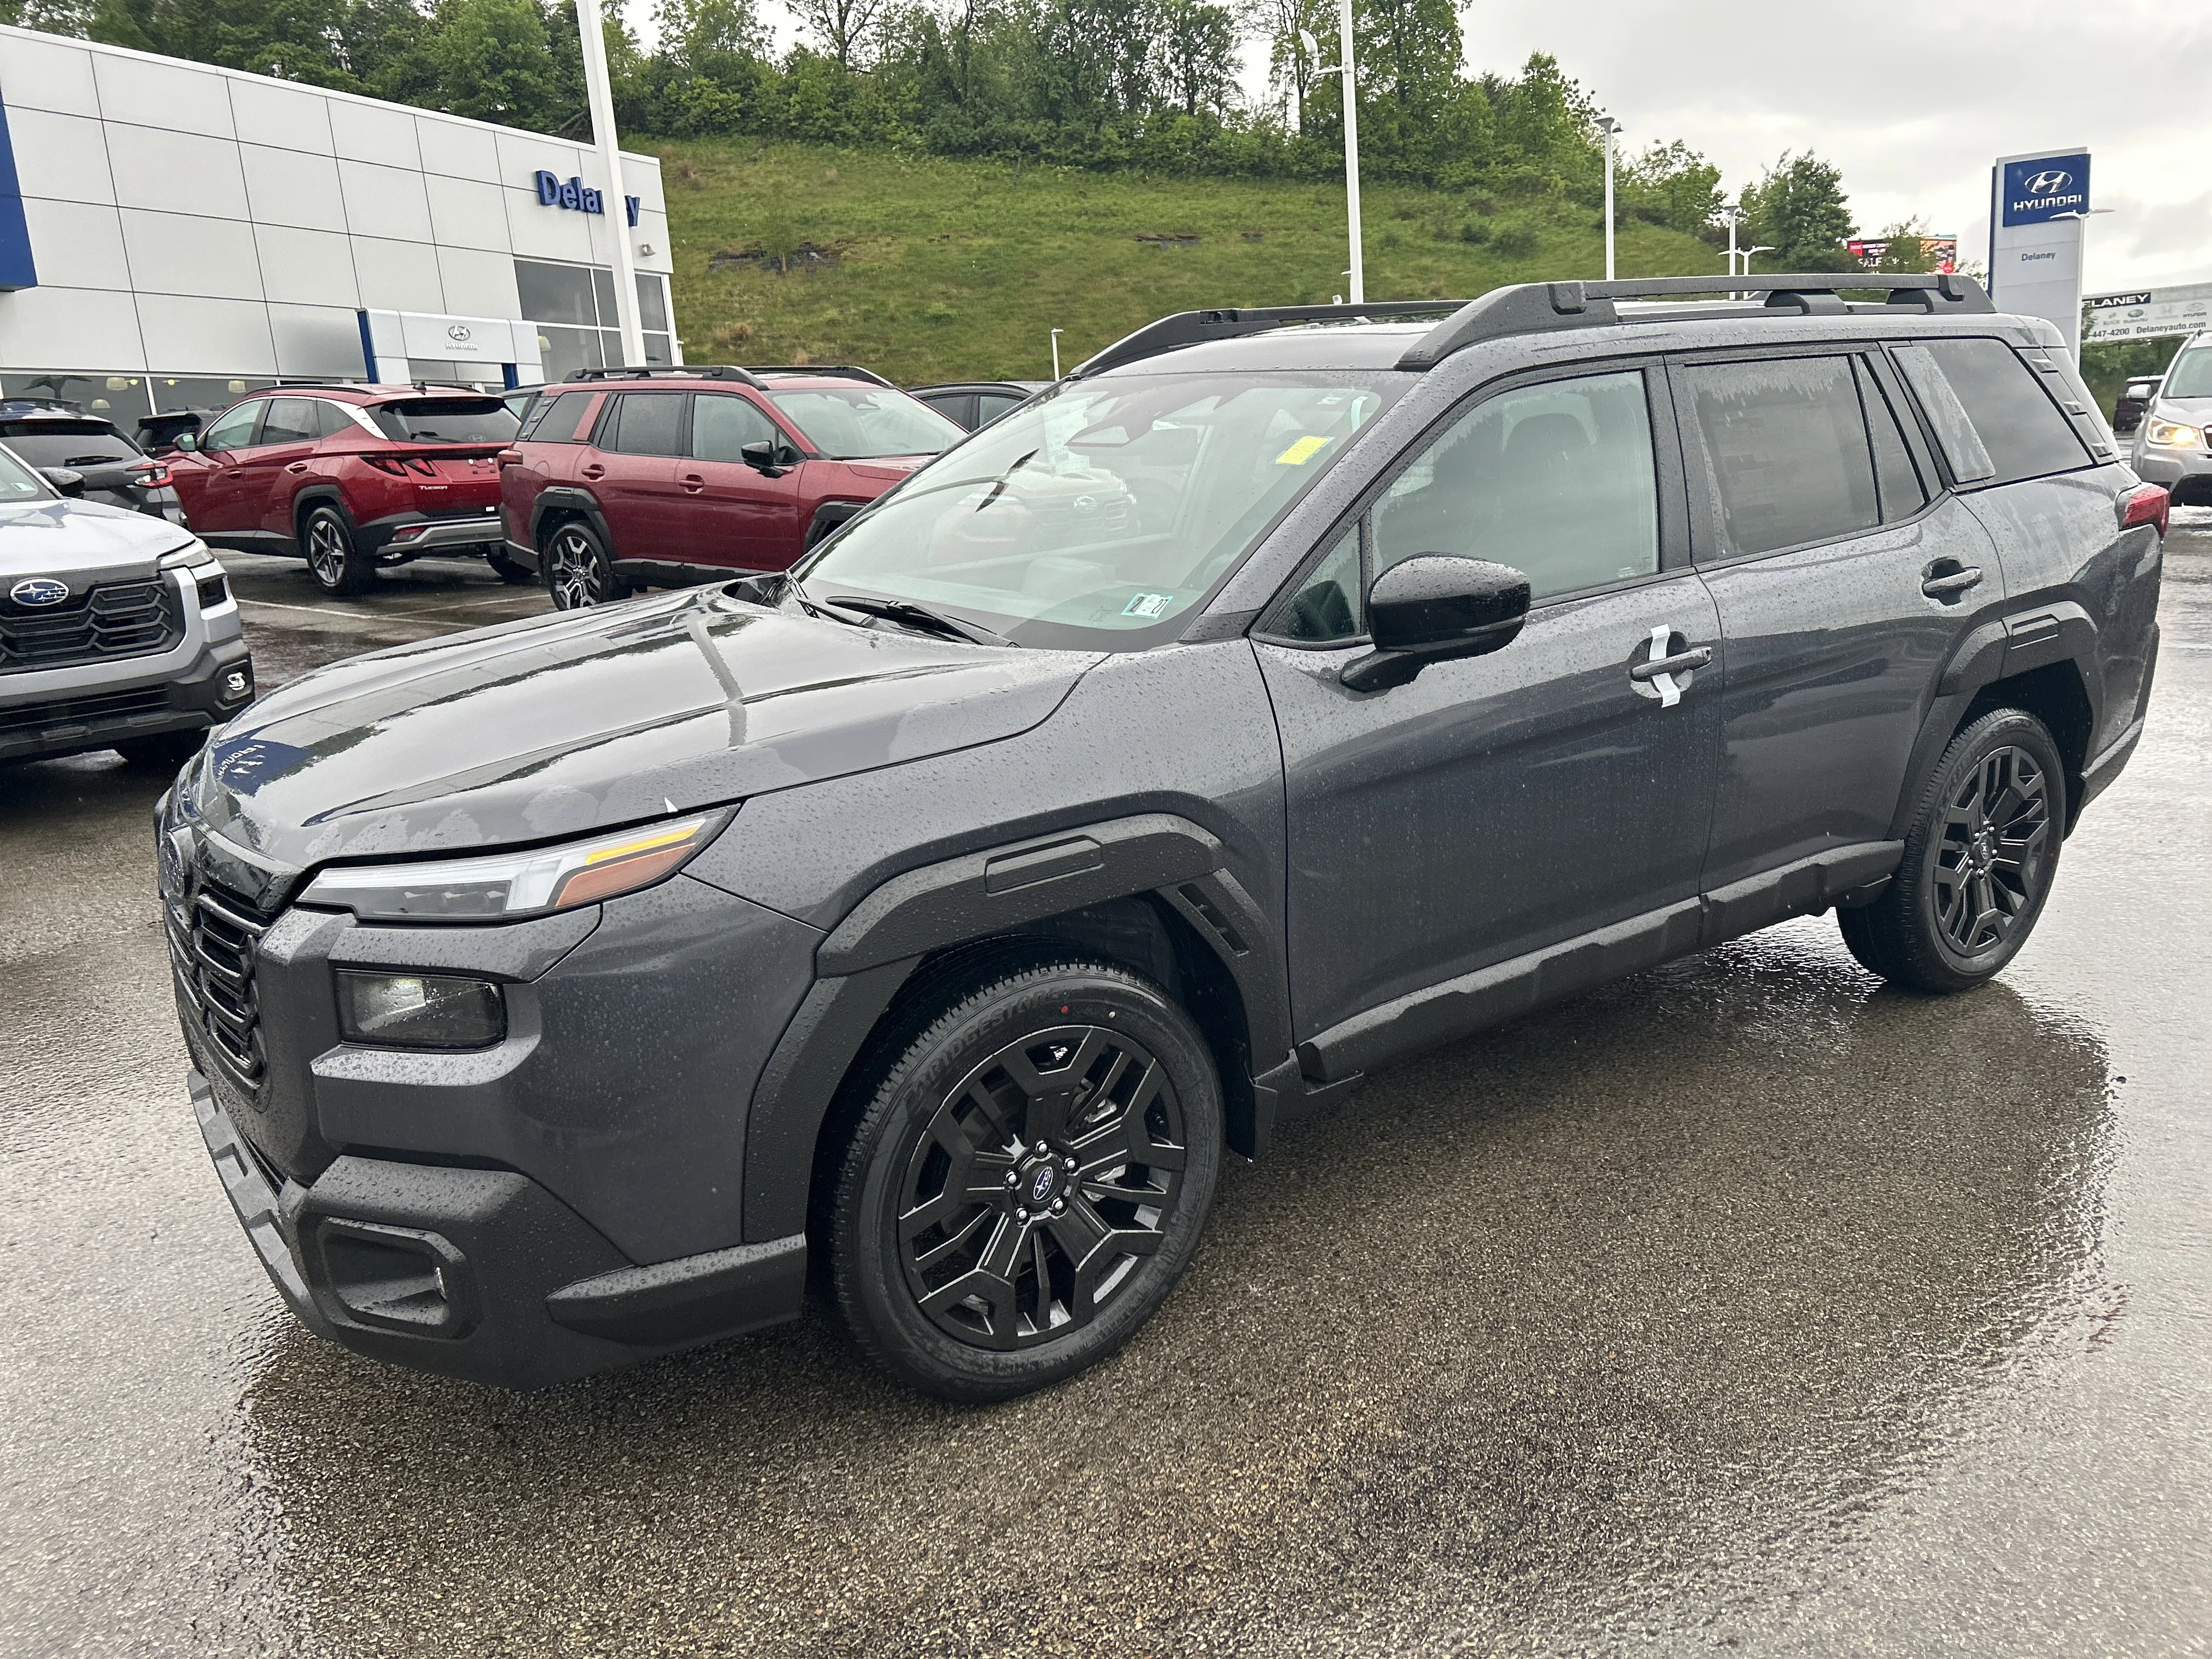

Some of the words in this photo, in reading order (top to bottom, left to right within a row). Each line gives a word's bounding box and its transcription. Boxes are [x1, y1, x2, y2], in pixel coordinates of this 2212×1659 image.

[535, 170, 640, 227] Delay
[2013, 194, 2082, 211] HYUNDAI
[2022, 252, 2056, 261] Delaney
[2136, 321, 2207, 334] Delaneyauto.com
[445, 342, 478, 351] HYUNDAI
